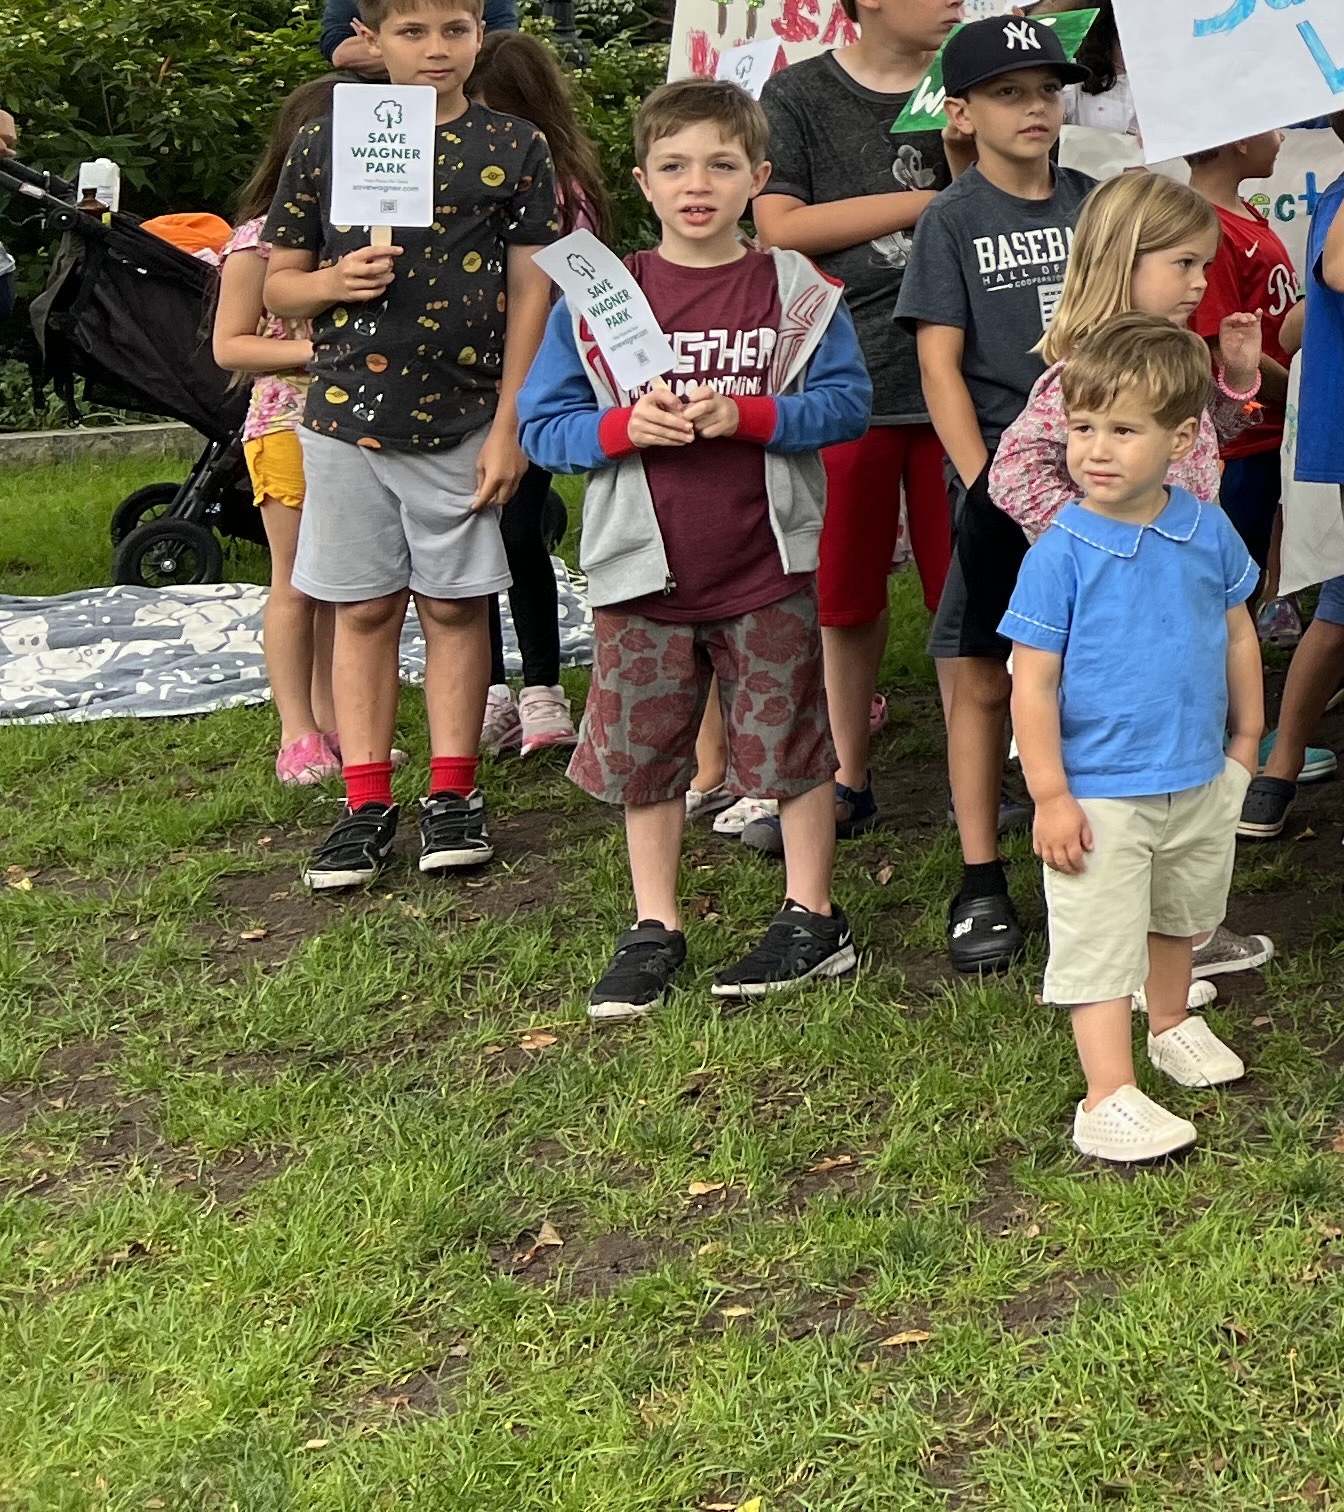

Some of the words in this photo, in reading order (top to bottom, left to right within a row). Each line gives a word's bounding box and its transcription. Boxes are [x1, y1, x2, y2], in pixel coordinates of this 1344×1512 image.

[1003, 20, 1041, 50] NY
[368, 132, 406, 144] SAVE
[351, 147, 421, 160] WAGNER
[366, 162, 407, 174] PARK
[982, 268, 1029, 286] HALL
[1041, 263, 1060, 275] OF
[587, 278, 614, 299] SAVE
[588, 289, 632, 318] WAGNER
[605, 308, 633, 329] PARK
[663, 327, 777, 374] ETHER
